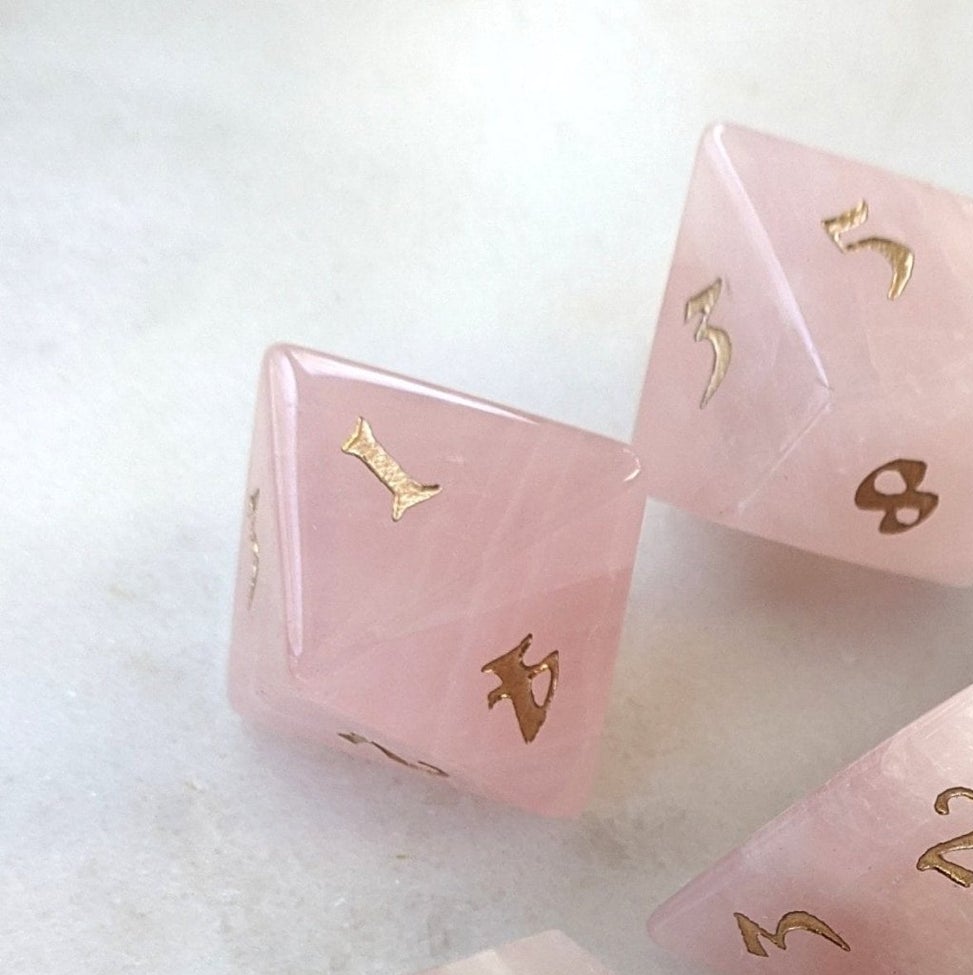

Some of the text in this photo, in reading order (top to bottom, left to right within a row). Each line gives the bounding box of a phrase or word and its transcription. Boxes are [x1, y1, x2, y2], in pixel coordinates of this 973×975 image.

[684, 277, 732, 410] 3
[341, 416, 442, 522] 1
[854, 458, 940, 534] 8
[480, 633, 559, 744] 4
[733, 912, 852, 958] 3
